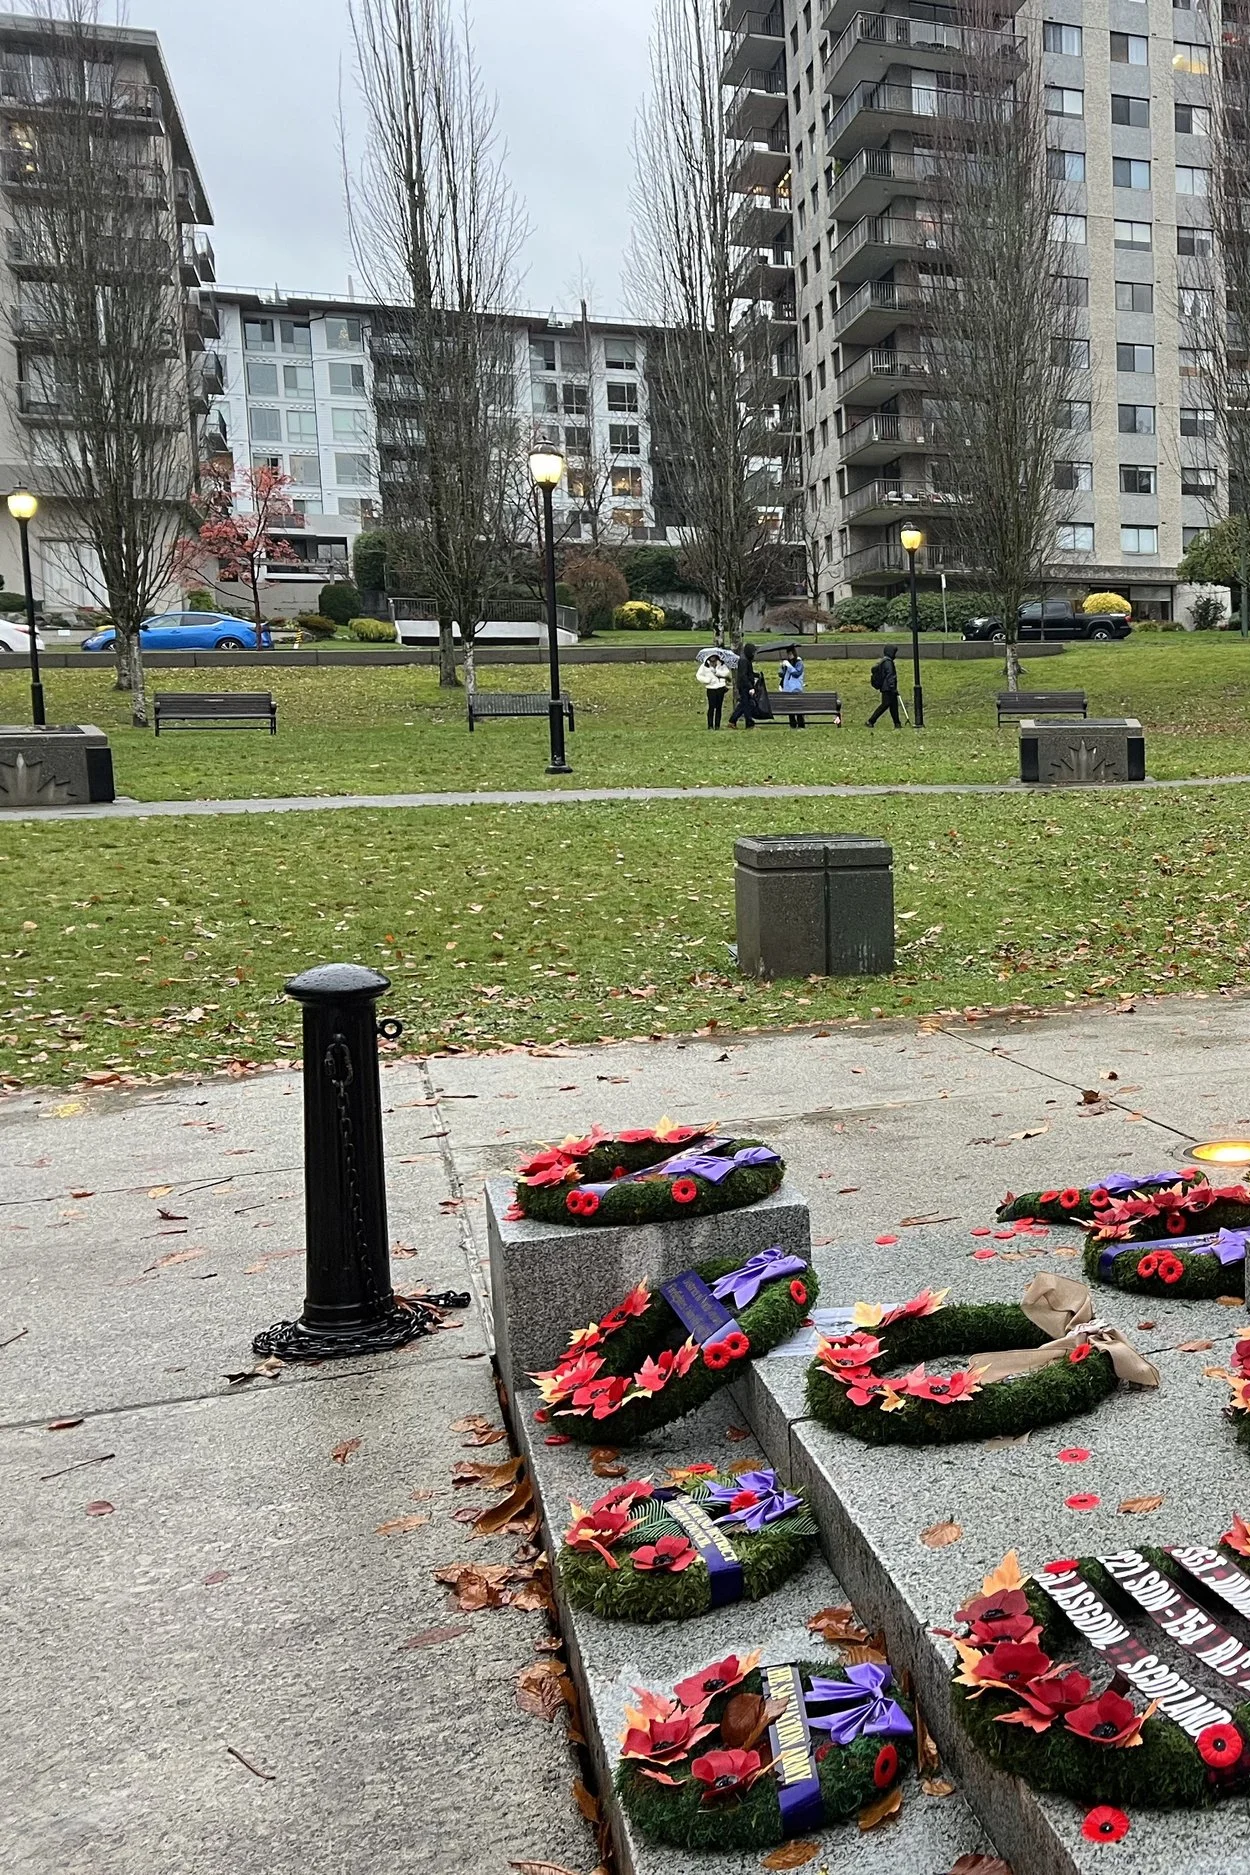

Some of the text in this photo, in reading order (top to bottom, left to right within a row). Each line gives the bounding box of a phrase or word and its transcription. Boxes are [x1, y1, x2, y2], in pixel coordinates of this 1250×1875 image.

[1095, 1549, 1150, 1579] 221
[1160, 1607, 1217, 1646] 154
[766, 1664, 794, 1687] THE
[780, 1745, 813, 1786] ARMY
[1116, 1654, 1233, 1738] SCOTLAND
